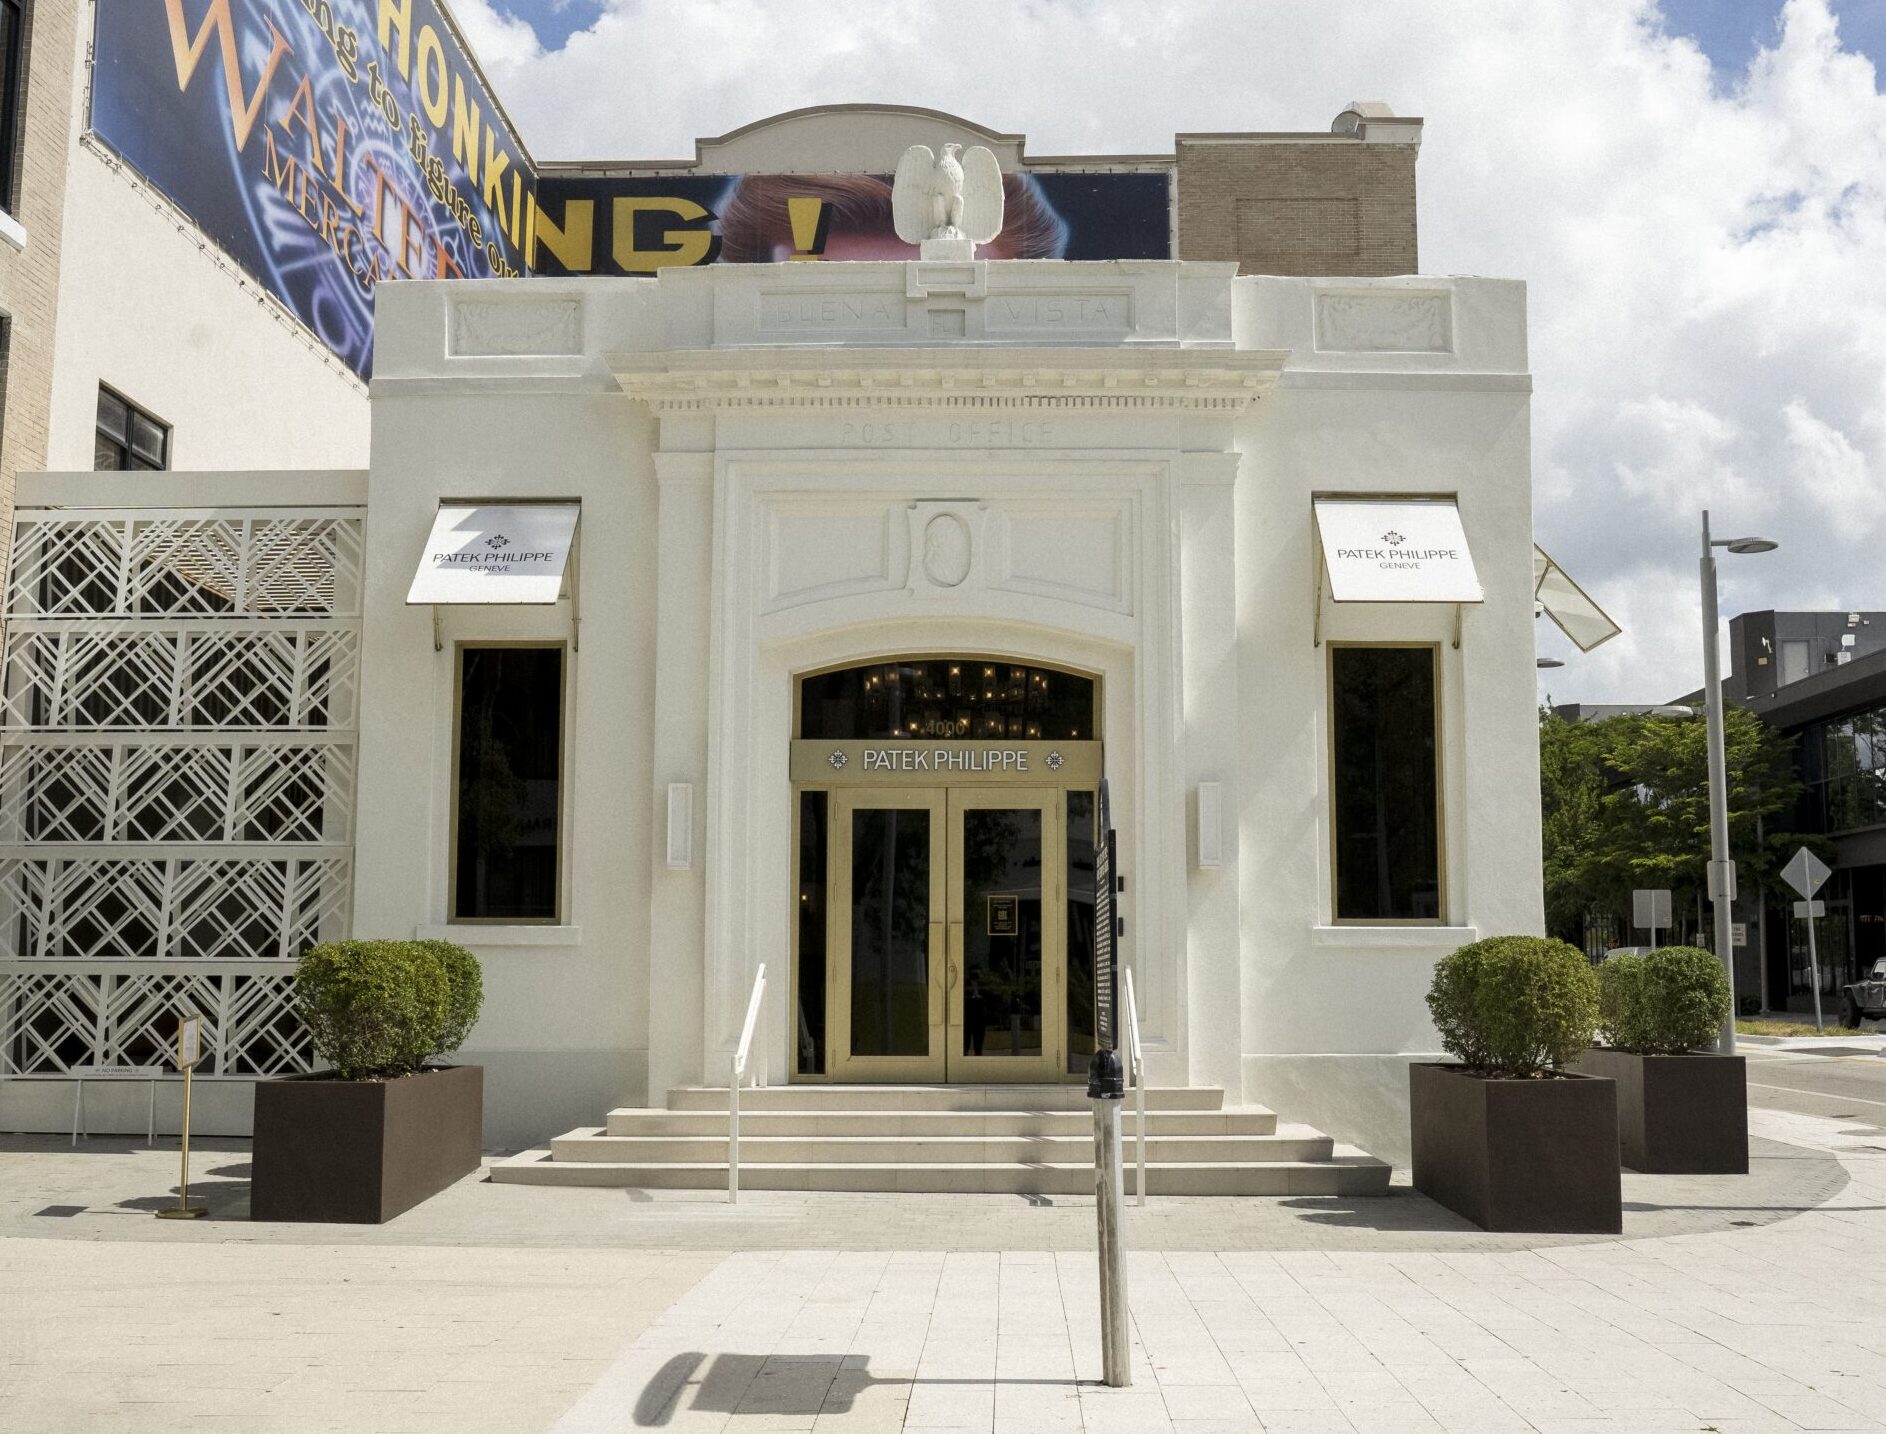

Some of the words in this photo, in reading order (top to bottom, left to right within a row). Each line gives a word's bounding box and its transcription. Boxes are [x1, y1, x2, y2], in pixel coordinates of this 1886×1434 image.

[368, 61, 401, 131] to
[409, 113, 483, 249] figure
[262, 122, 397, 287] MERCA
[777, 301, 890, 322] BUENA
[1003, 299, 1110, 322] VISTA
[842, 423, 916, 443] POST
[949, 421, 1054, 443] OFFICE
[432, 553, 481, 563] PATEK
[484, 552, 554, 562] PHILIPPE
[1337, 549, 1385, 560] PATEK
[1388, 549, 1459, 560] PHILIPPE
[1379, 562, 1422, 570] GENEVE
[926, 720, 966, 736] 4000
[863, 750, 928, 770] PATEK
[934, 750, 1028, 771] PHILIPPE
